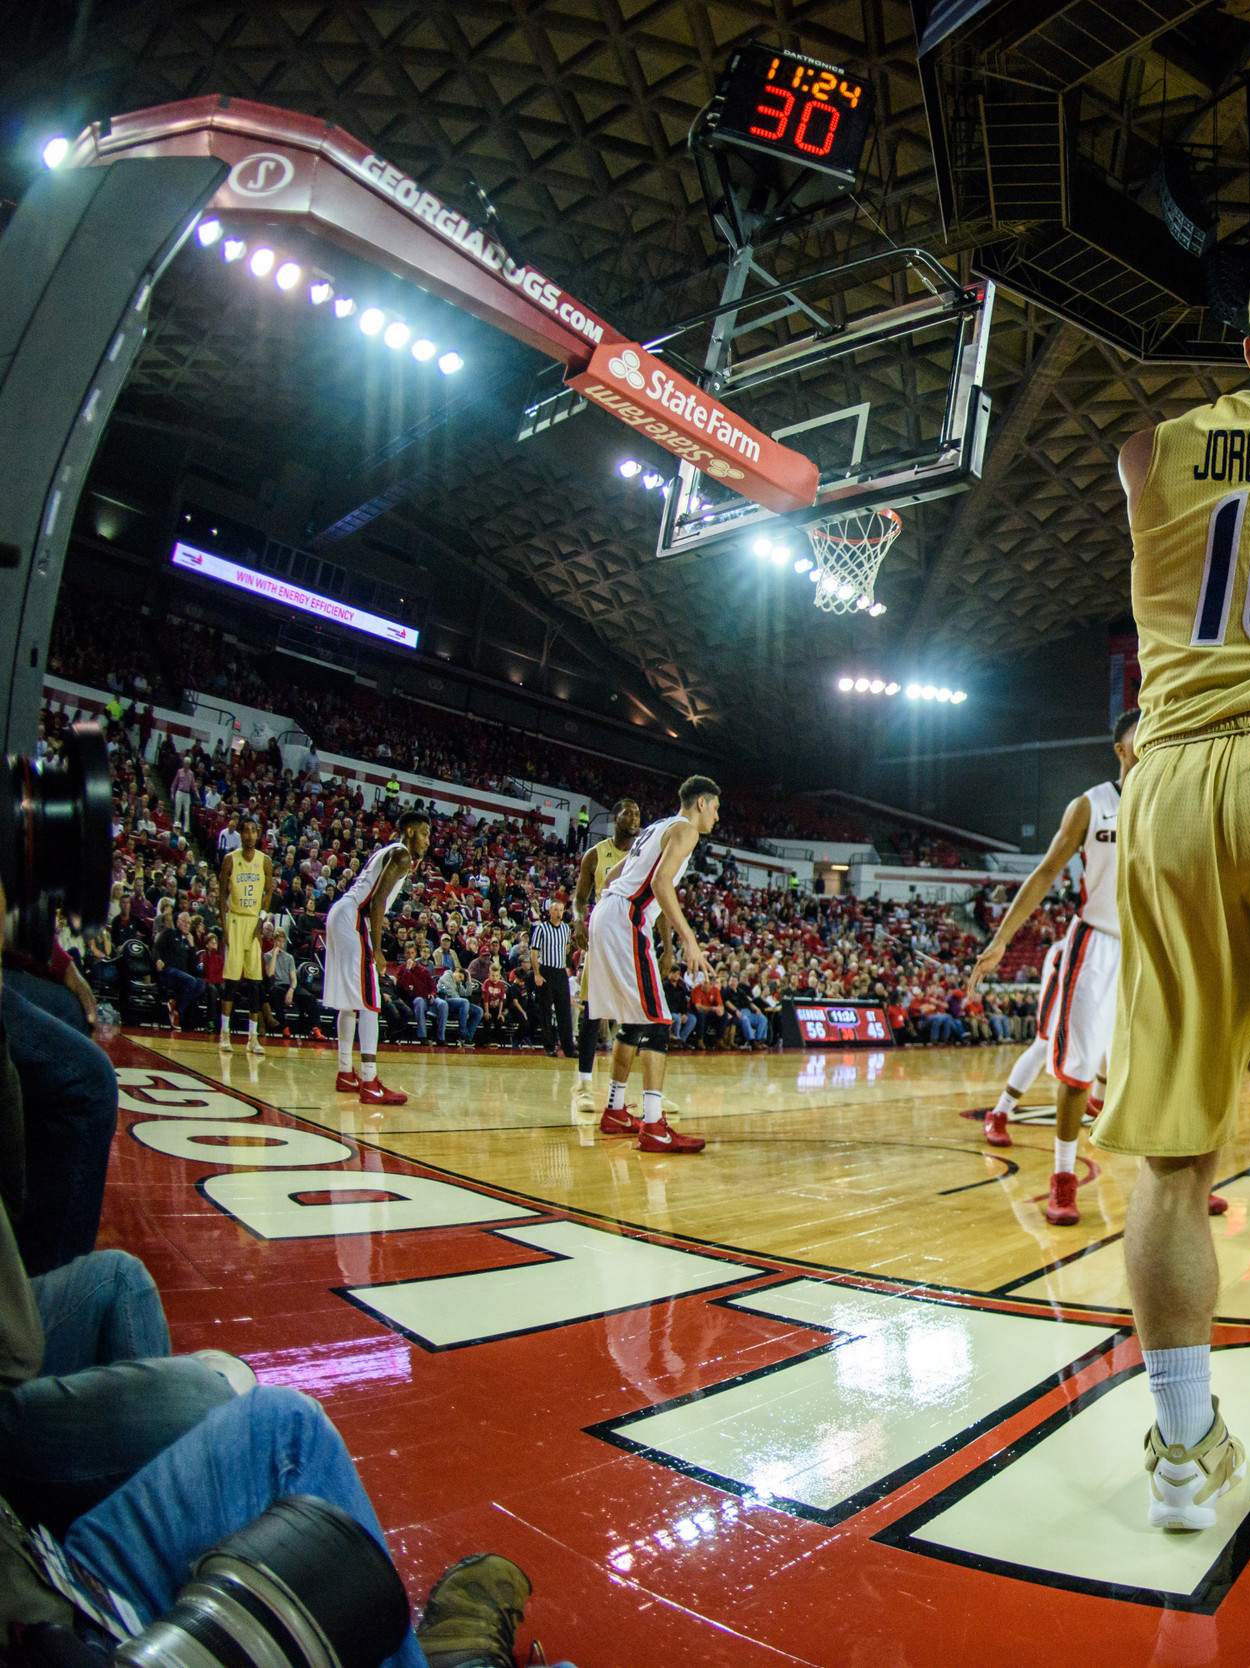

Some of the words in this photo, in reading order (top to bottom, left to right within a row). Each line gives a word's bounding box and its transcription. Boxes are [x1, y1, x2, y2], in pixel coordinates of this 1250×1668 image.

[783, 49, 845, 75] DAKTRONICS
[767, 57, 861, 108] 11:24
[750, 85, 840, 156] 30
[236, 570, 254, 586] WIN
[255, 576, 278, 594] WITH
[278, 586, 311, 606] ENERGY
[310, 598, 355, 621] EFFICIENCY
[236, 873, 260, 883] GEORGIA
[243, 884, 254, 896] 12
[239, 898, 257, 907] TECH
[806, 1022, 826, 1039] 56
[867, 1022, 885, 1039] 45
